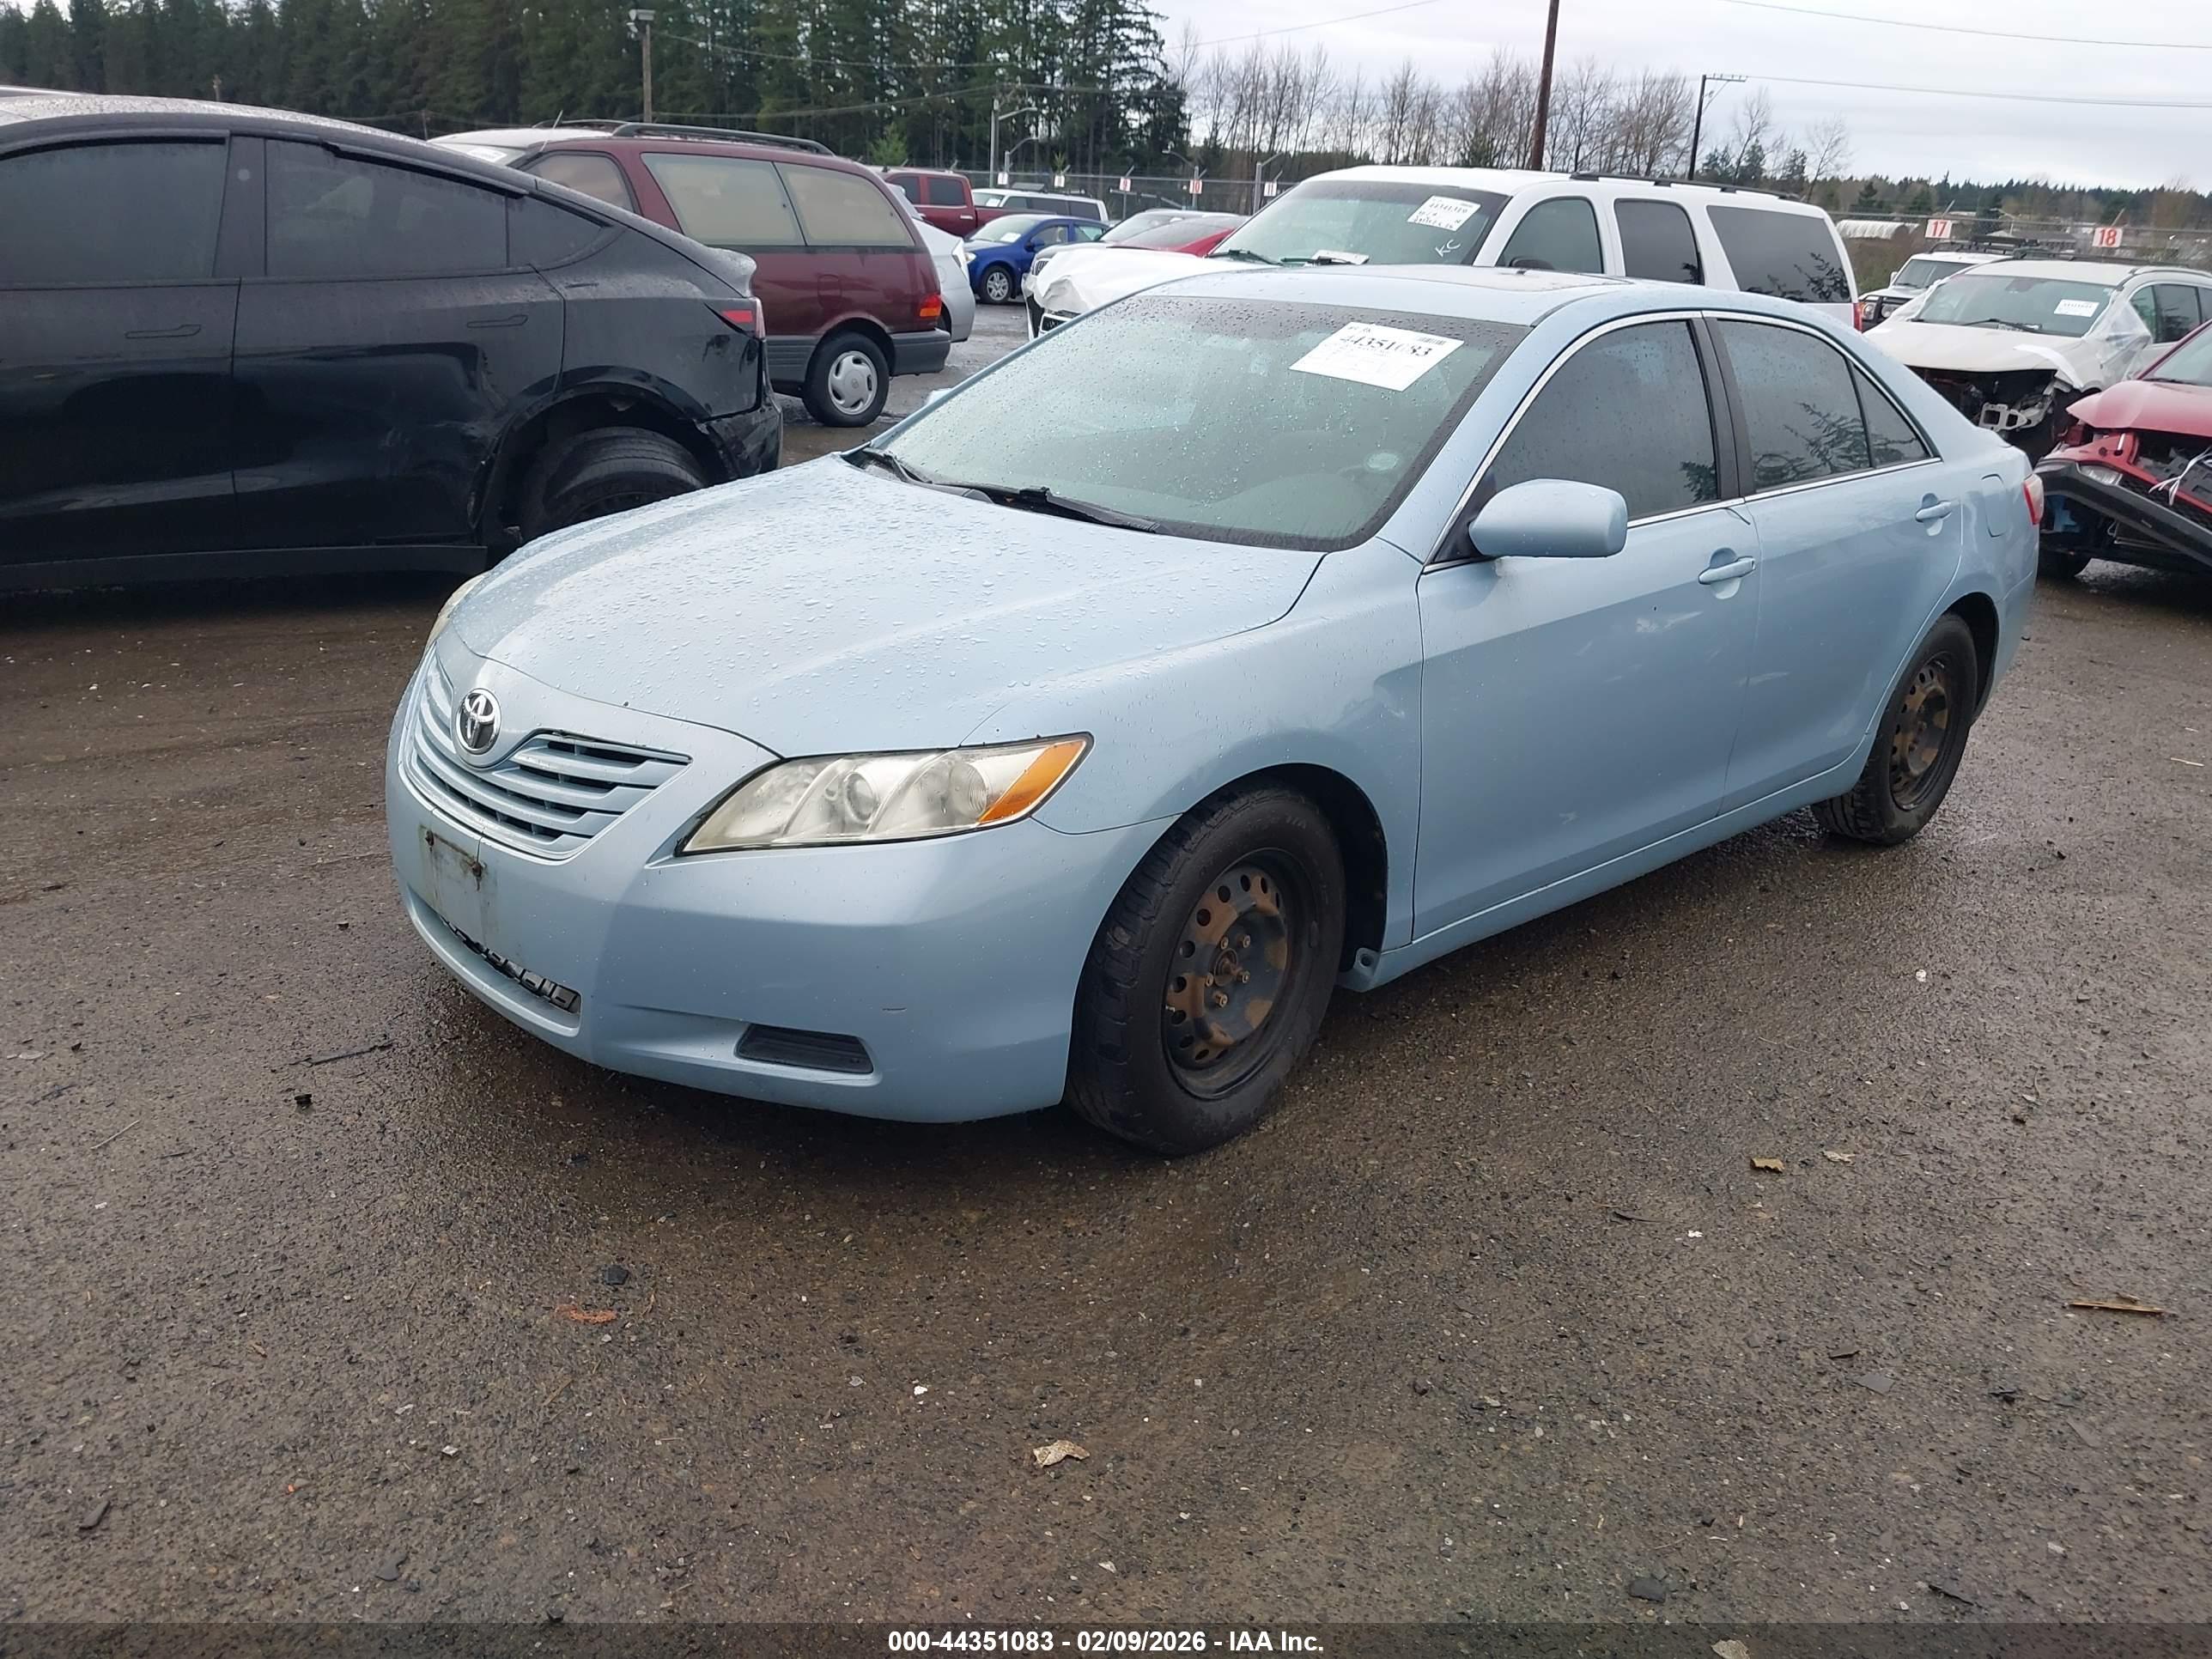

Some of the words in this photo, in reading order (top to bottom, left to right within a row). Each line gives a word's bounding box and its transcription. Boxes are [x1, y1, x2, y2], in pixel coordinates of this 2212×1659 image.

[1192, 179, 1201, 191] 10
[1932, 220, 1948, 237] 17
[2099, 228, 2118, 246] 18
